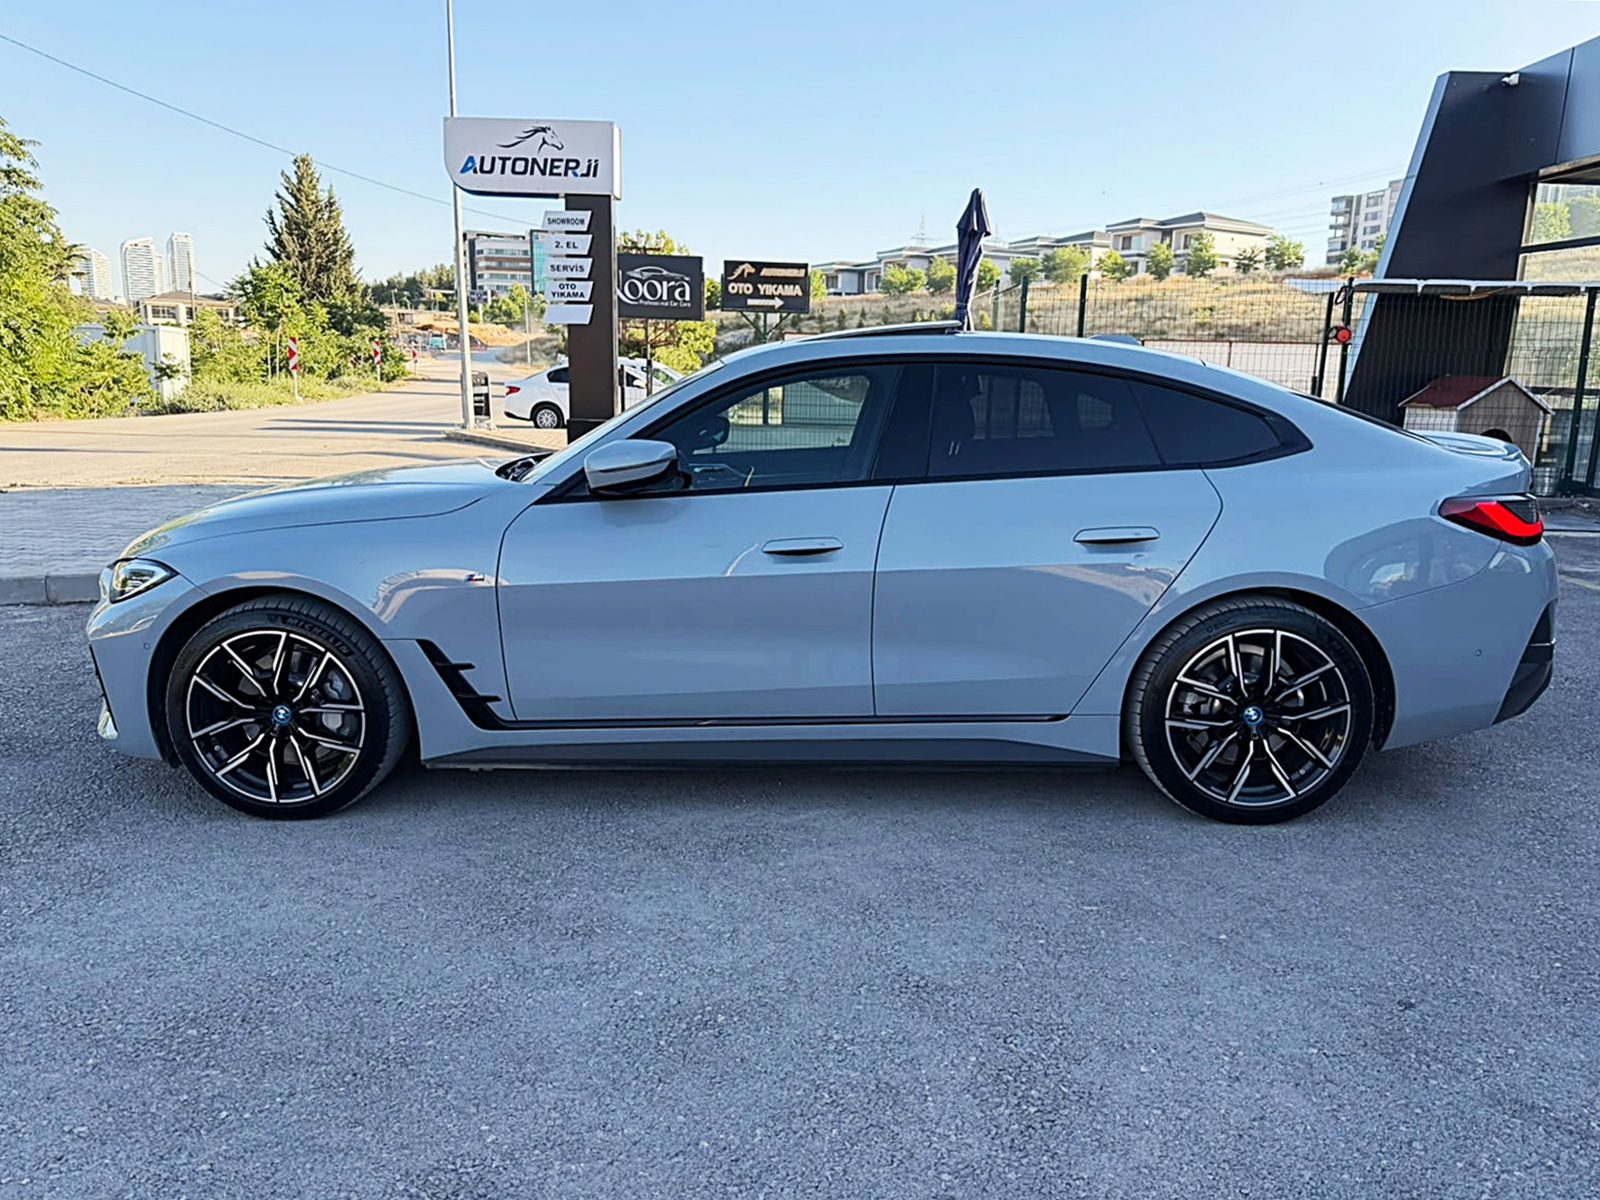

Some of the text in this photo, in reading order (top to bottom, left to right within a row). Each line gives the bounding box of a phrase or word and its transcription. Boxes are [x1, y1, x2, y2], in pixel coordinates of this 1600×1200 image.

[547, 217, 586, 226] SHOWROOM
[554, 241, 578, 249] 2. EL
[727, 282, 803, 297] OTO YIKAMA
[551, 291, 586, 299] YIKAMA
[286, 617, 350, 656] MICHELIN
